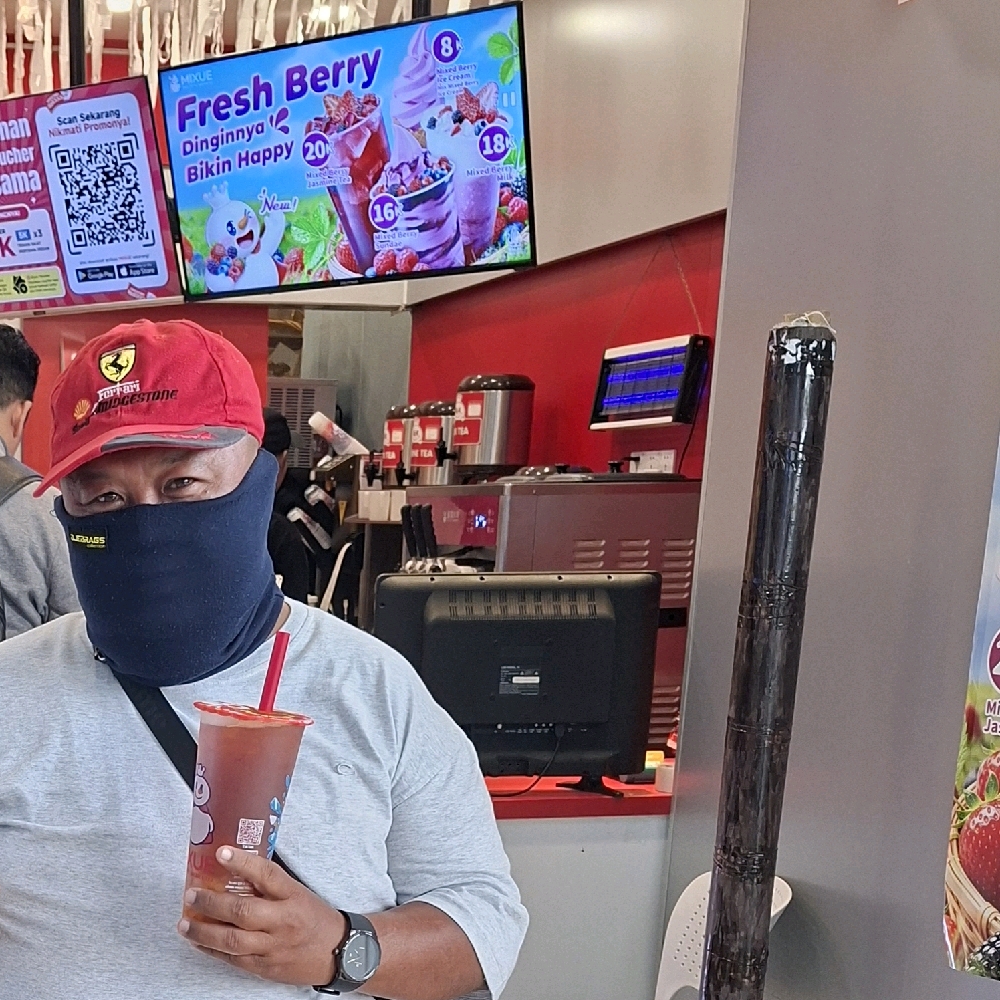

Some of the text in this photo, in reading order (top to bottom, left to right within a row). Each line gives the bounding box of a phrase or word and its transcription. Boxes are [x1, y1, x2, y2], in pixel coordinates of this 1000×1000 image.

[180, 69, 213, 85] MIXUE
[177, 47, 383, 133] Fresh Berry
[48, 116, 131, 138] Nikmati Promonya!
[56, 109, 121, 126] Scan Sekarang
[182, 121, 265, 157] Dinginnya
[186, 140, 294, 184] Bikin Happy
[260, 194, 298, 213] New!
[33, 228, 43, 237] x3
[97, 380, 141, 401] Ferrari
[986, 700, 1000, 716] Mi
